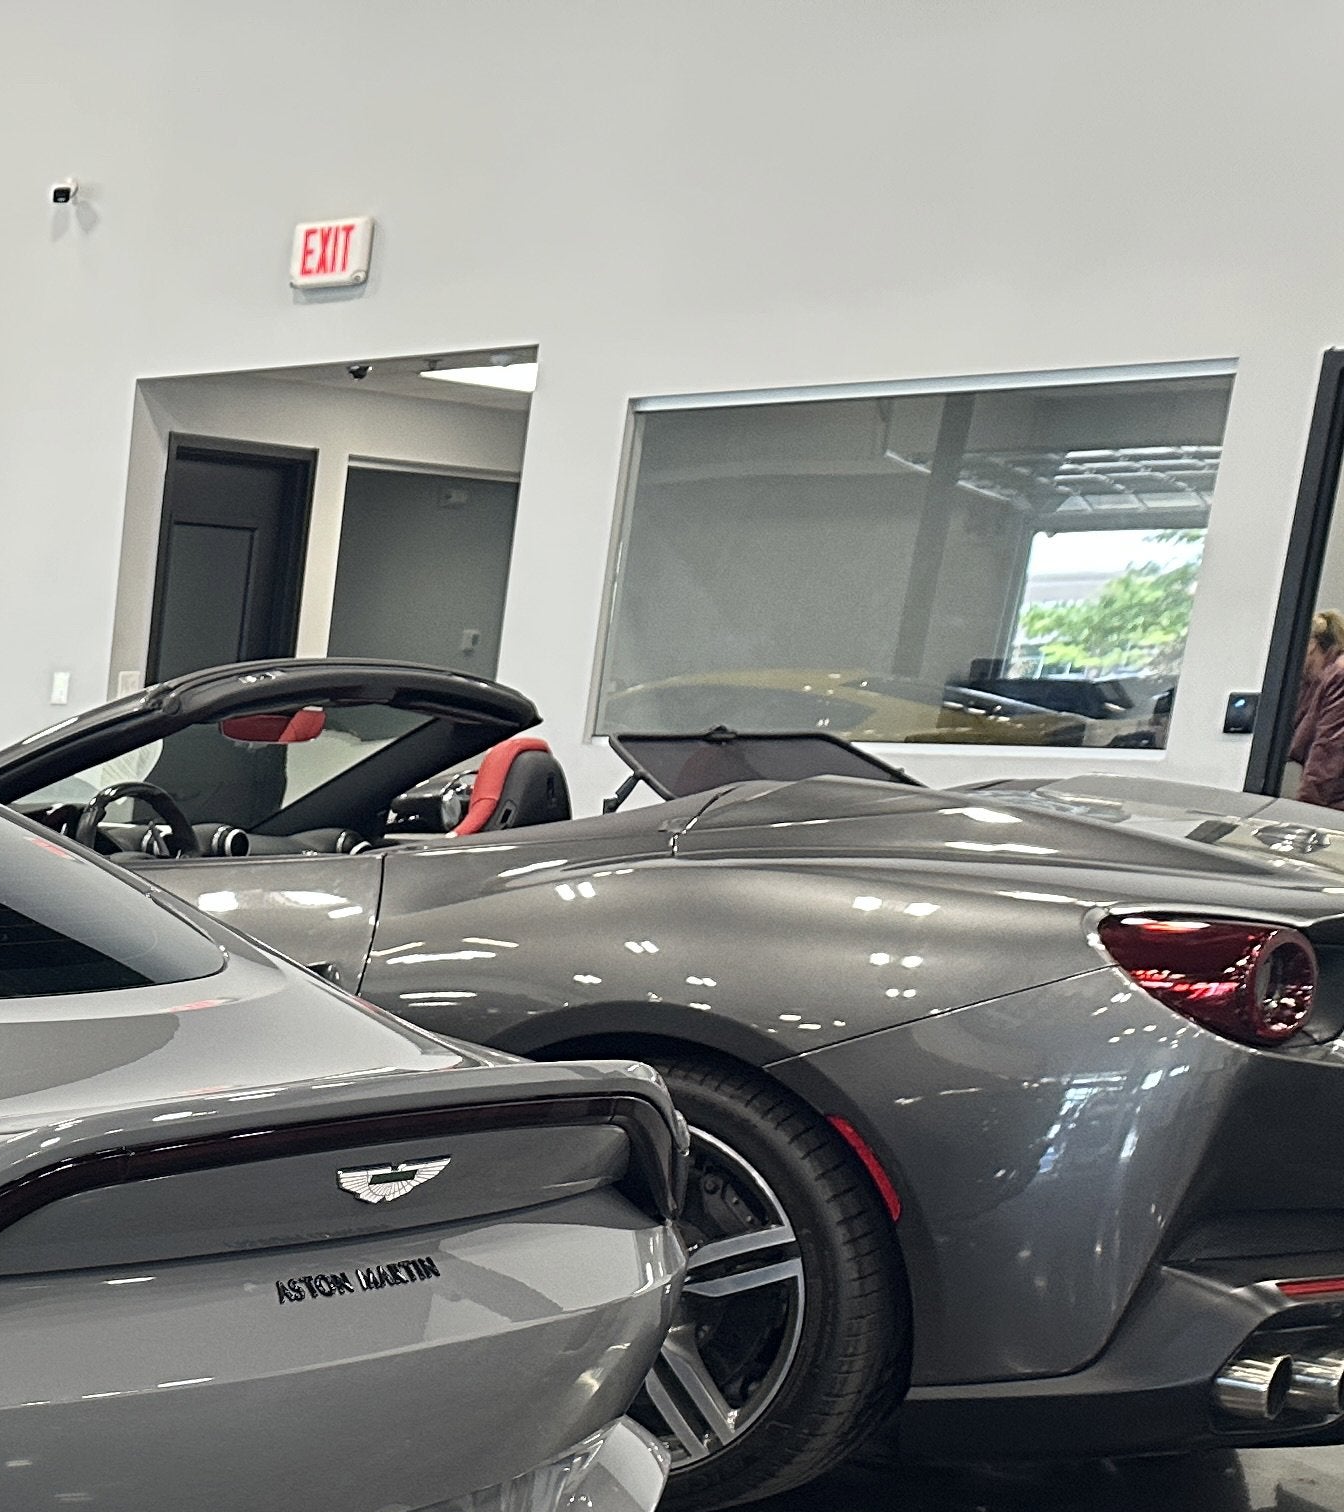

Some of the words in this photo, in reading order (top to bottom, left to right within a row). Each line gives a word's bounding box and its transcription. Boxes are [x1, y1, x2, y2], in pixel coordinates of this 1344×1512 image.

[300, 224, 355, 276] EXIT
[275, 1272, 354, 1304] ASTON
[355, 1256, 441, 1292] MARTIN
